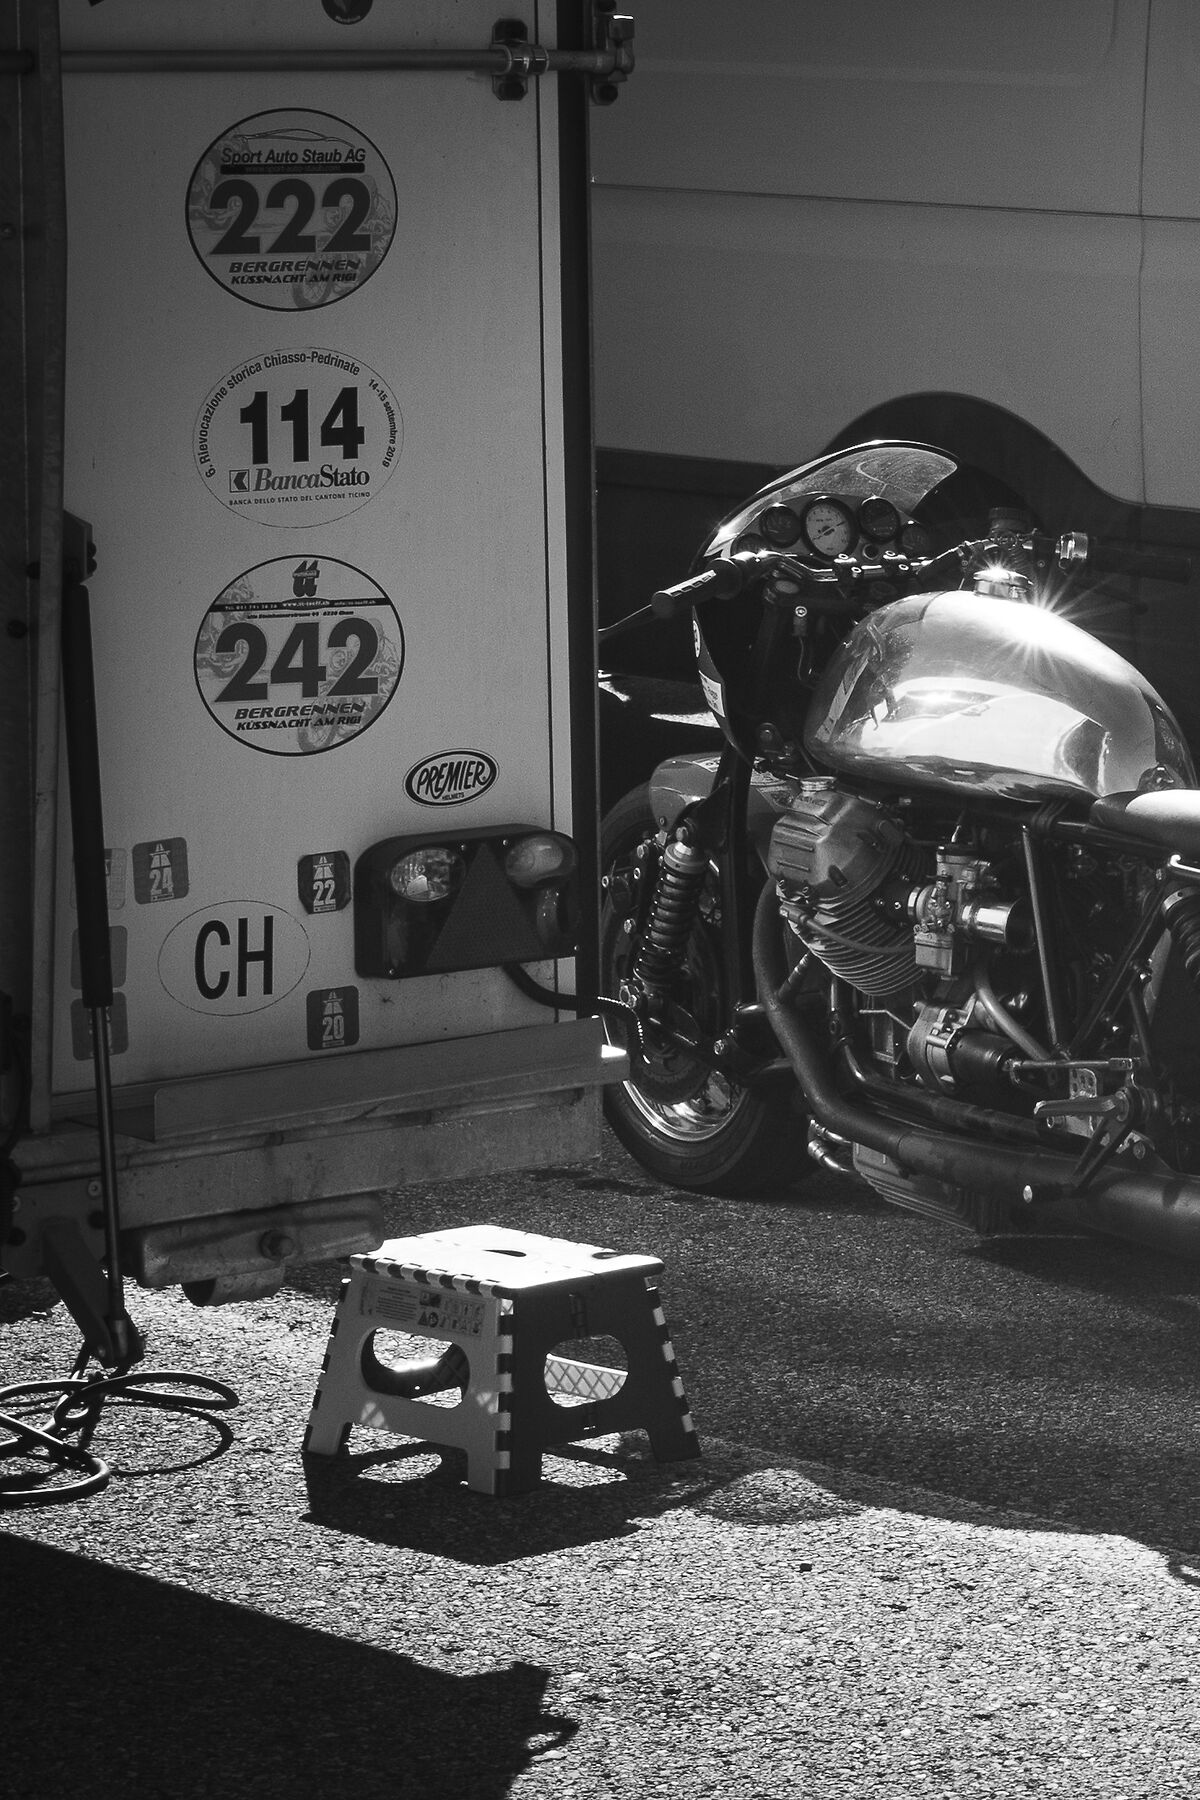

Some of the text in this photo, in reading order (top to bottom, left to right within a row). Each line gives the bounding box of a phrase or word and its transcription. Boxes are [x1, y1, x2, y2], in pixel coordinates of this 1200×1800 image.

[221, 148, 366, 165] Sport Auto Staub AG
[209, 178, 371, 254] 222
[229, 260, 361, 274] BERGRENNEN
[309, 274, 332, 283] AM
[333, 272, 357, 282] RIGI
[198, 386, 228, 465] Rievocazione
[227, 362, 262, 389] storica
[264, 351, 360, 376] Chiasso-Pedrinate
[240, 386, 365, 465] 114
[368, 378, 398, 468] 14-15 settembre 2019
[253, 464, 370, 492] BancaStato
[315, 493, 346, 501] CANTONE
[214, 617, 379, 702] 242
[235, 702, 366, 720] BERGRENNEN
[314, 717, 337, 727] AM
[416, 760, 487, 800] PREMIER
[149, 867, 174, 895] 24
[313, 879, 336, 905] 22
[195, 915, 273, 1000] CH
[322, 1015, 344, 1041] 20
